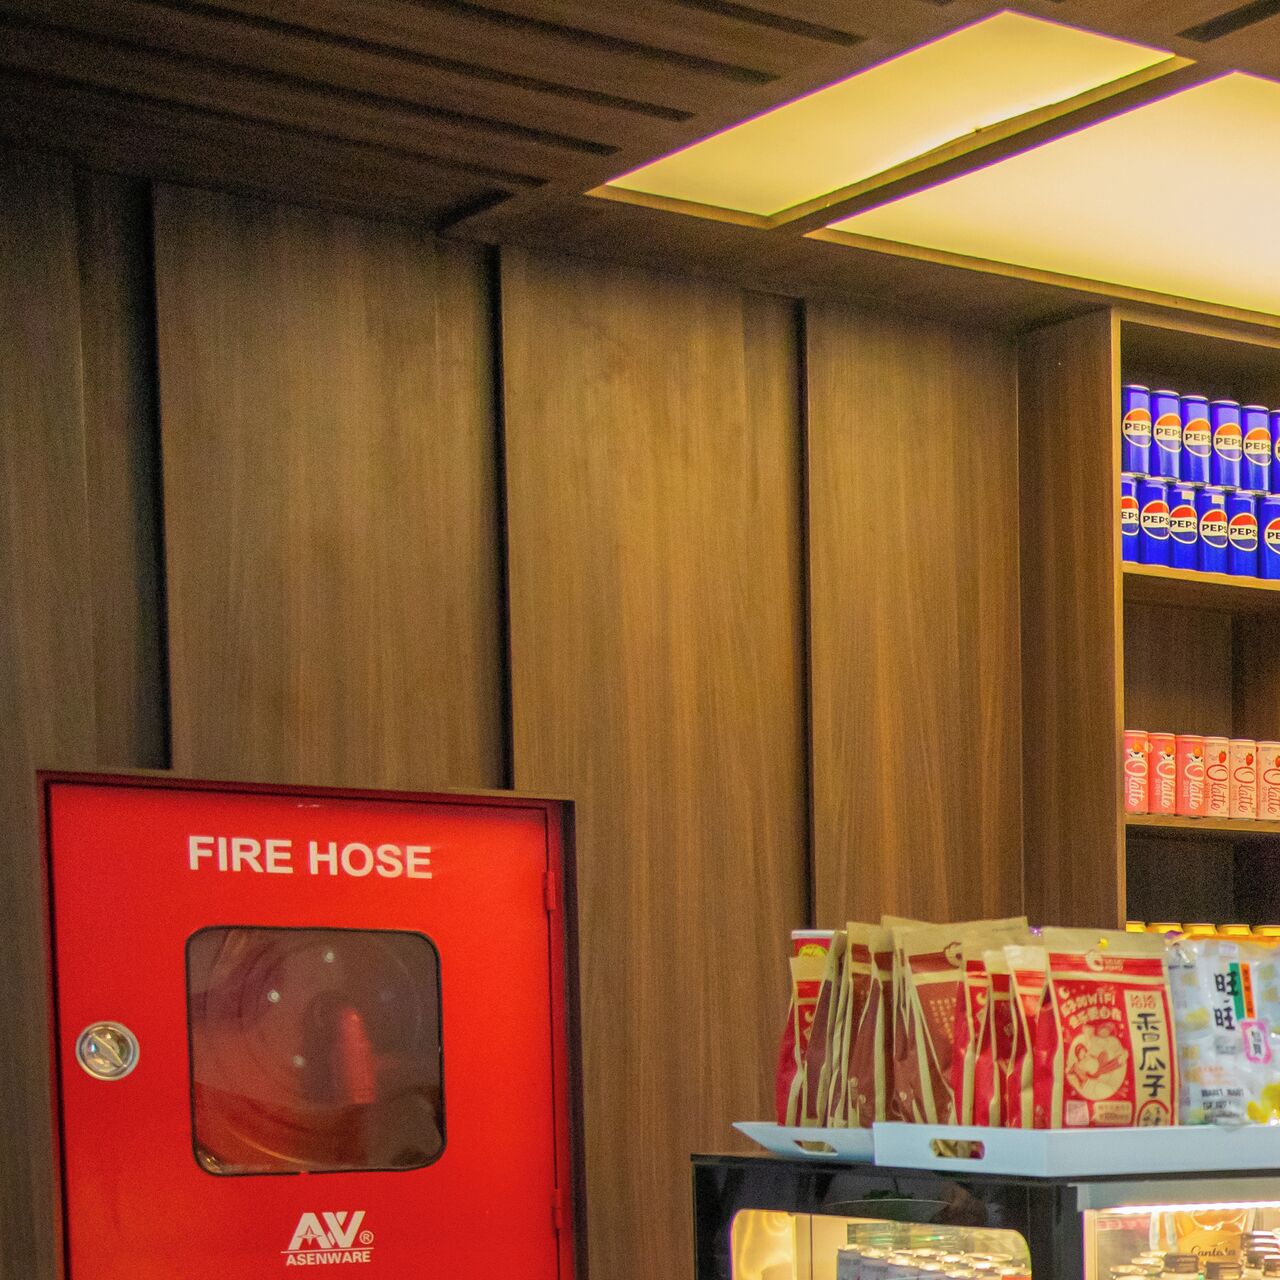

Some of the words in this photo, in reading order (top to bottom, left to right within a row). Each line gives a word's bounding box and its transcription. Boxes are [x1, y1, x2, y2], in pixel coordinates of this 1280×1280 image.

[189, 836, 293, 874] FIRE
[310, 842, 433, 880] HOSE
[1137, 1013, 1166, 1097] 香瓜子
[286, 1250, 372, 1267] ASENWARE
